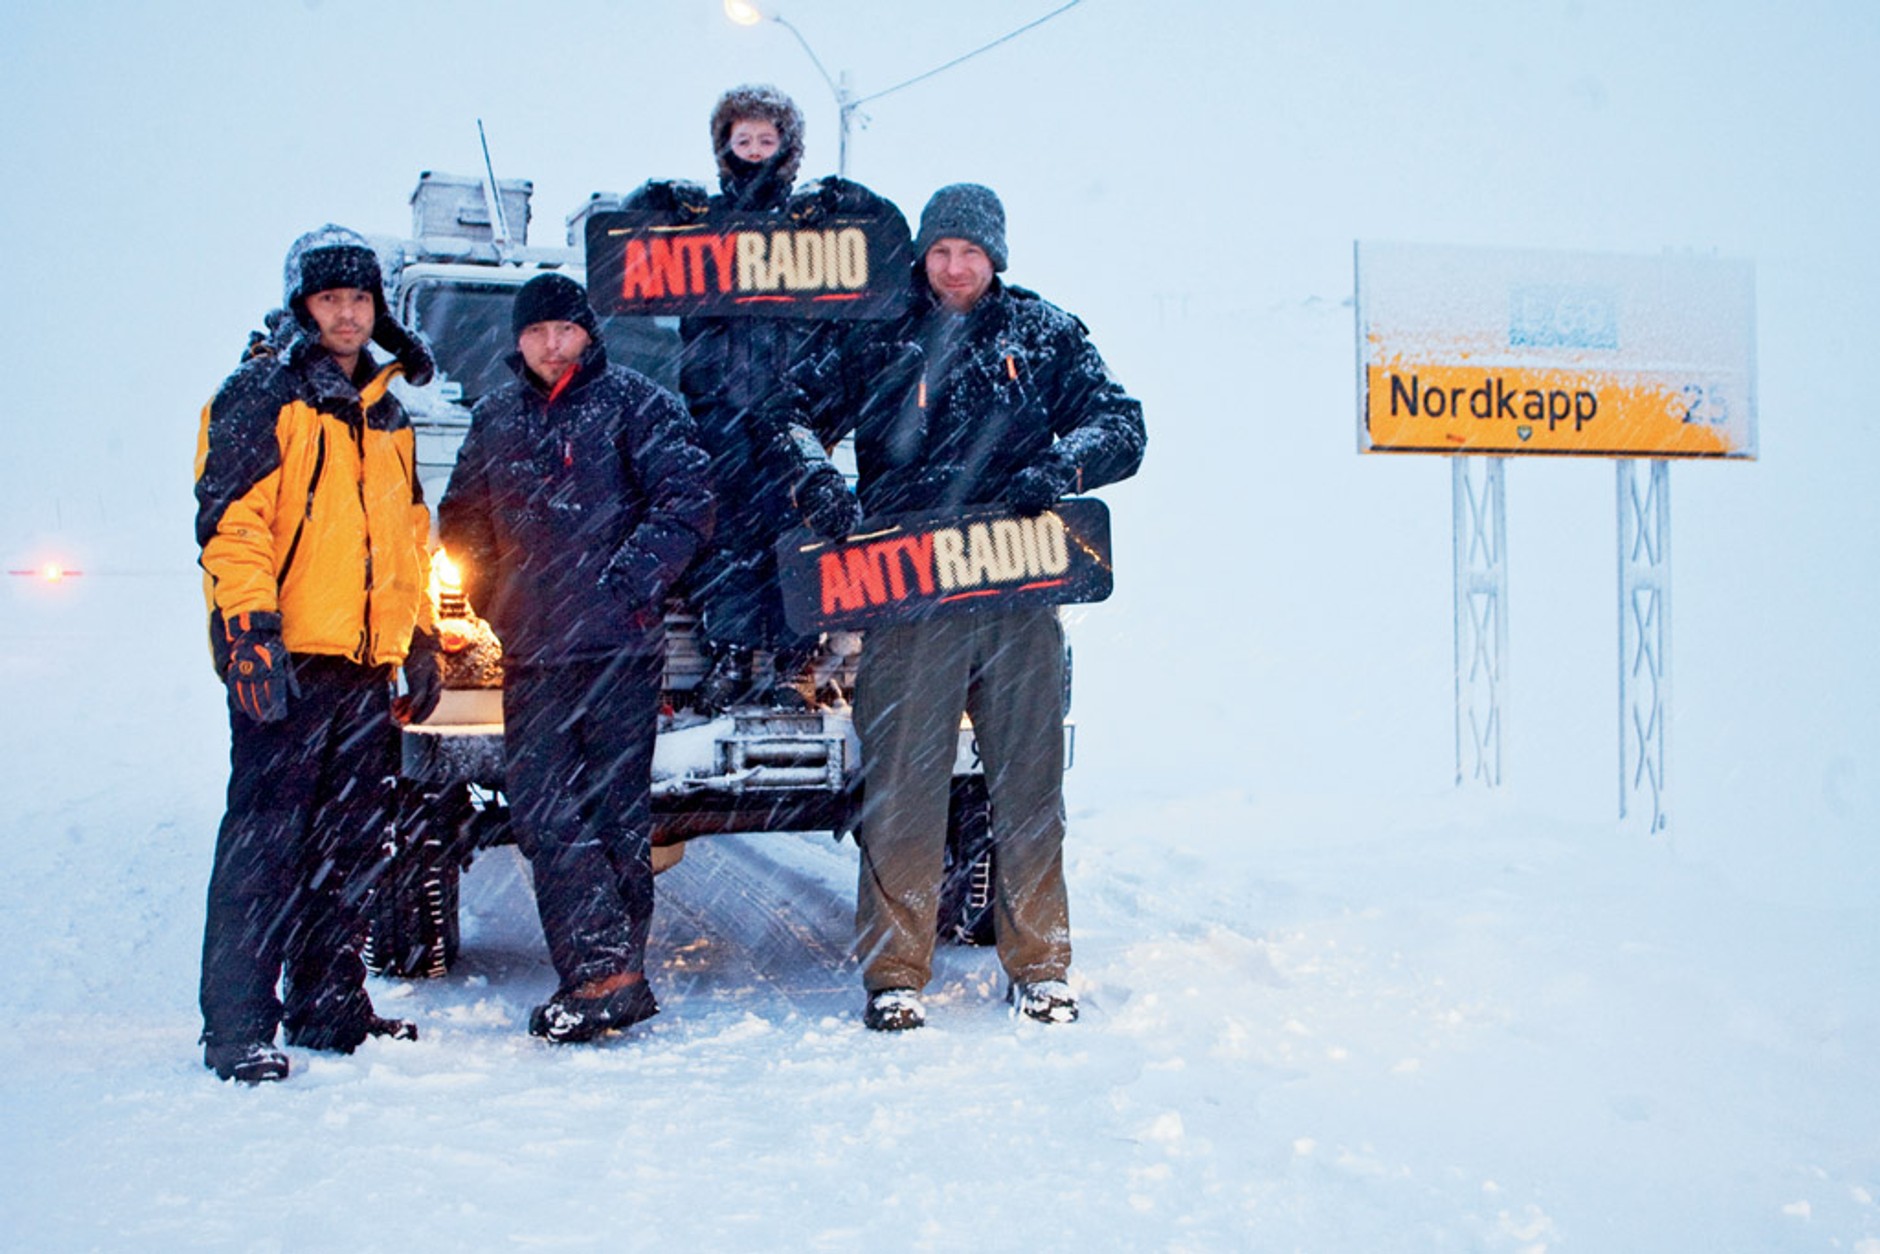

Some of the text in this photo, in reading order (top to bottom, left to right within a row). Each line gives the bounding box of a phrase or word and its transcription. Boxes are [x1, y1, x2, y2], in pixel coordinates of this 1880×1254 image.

[622, 226, 869, 300] ANTYRADIO
[1390, 373, 1598, 431] Nordkapp
[819, 511, 1070, 615] ANTYRADIO
